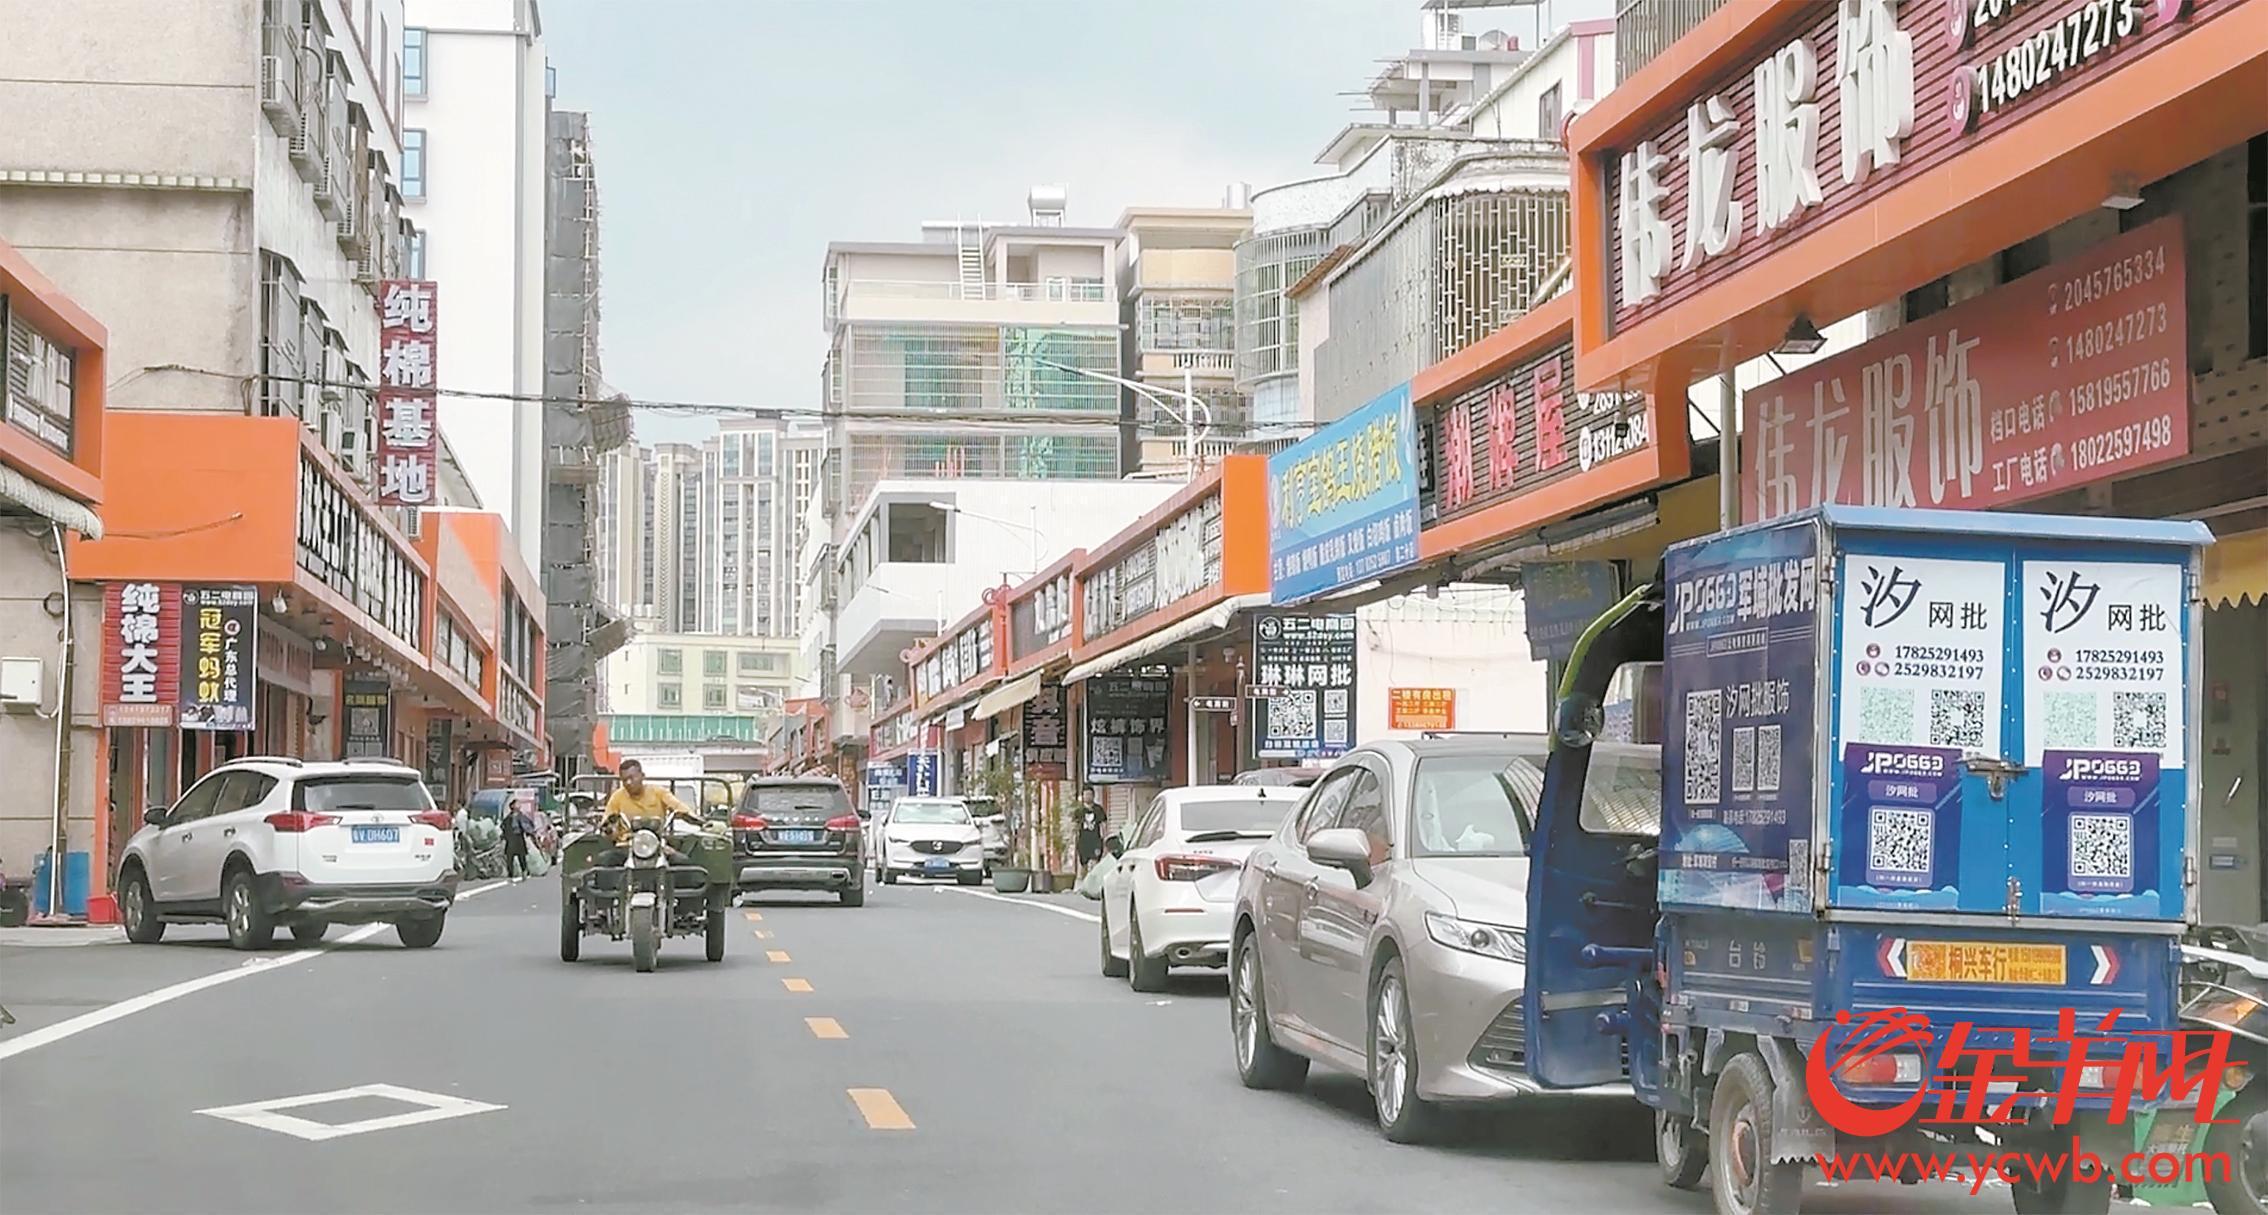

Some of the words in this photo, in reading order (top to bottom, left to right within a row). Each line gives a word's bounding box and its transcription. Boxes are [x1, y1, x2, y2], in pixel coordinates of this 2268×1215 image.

[1618, 0, 1914, 308] 伟龙服饰
[2064, 246, 2165, 311] 2045765334
[2066, 302, 2167, 364] 1480247273
[381, 283, 433, 503] 纯棉基地
[2069, 358, 2170, 417] 15819557766
[1755, 328, 1983, 522] 伟龙服饰
[1990, 394, 2045, 444] 档口电话
[2071, 415, 2172, 471] 18022597498
[1991, 447, 2048, 492] 工厂电话
[119, 583, 160, 702] 纯棉大王
[199, 607, 222, 703] 冠军蚂蚁
[1895, 645, 1984, 663] 17825291493
[2075, 649, 2164, 664] 17825291493
[1261, 663, 1352, 687] 琳琳网批
[1894, 662, 1983, 680] 2529832197
[2075, 667, 2164, 681] 2529832197
[1726, 678, 1790, 719] 汐网批服饰
[1885, 784, 1919, 799] 汐网批
[2084, 790, 2117, 803] 汐网批
[1949, 946, 2007, 981] 桐兴车行
